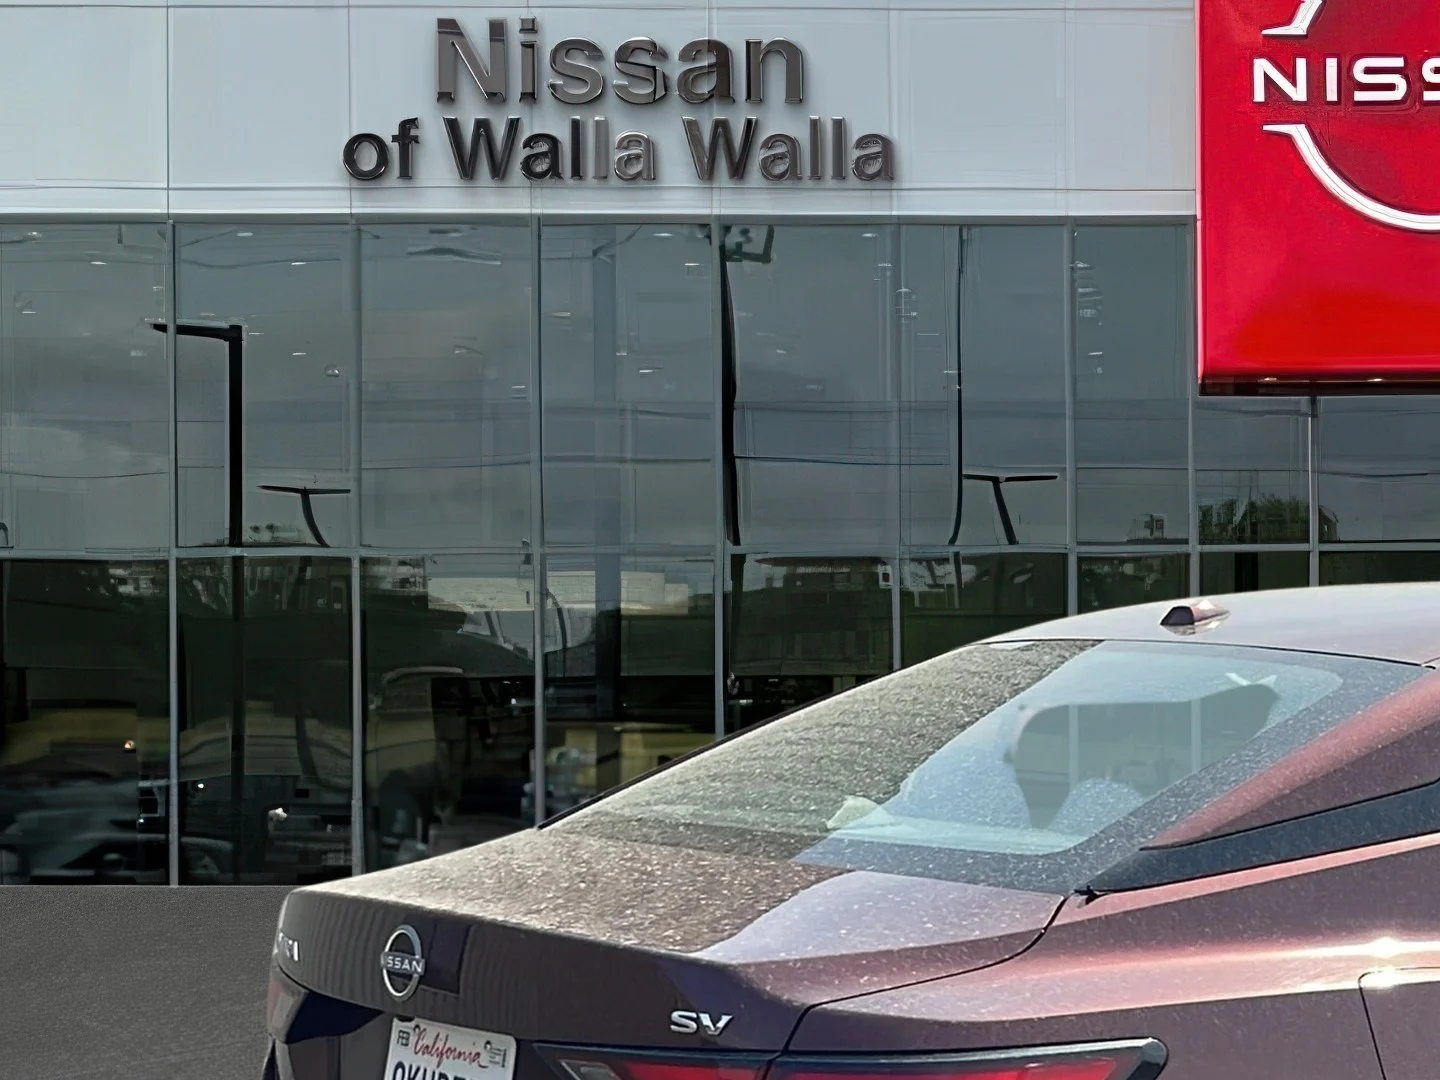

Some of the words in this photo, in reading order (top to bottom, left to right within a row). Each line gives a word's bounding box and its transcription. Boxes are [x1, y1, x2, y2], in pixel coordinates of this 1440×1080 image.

[436, 17, 804, 104] Nissan
[342, 117, 420, 182] of
[442, 115, 657, 182] Walla
[681, 115, 894, 182] Walla
[413, 1026, 489, 1069] California
[669, 1010, 733, 1036] SV
